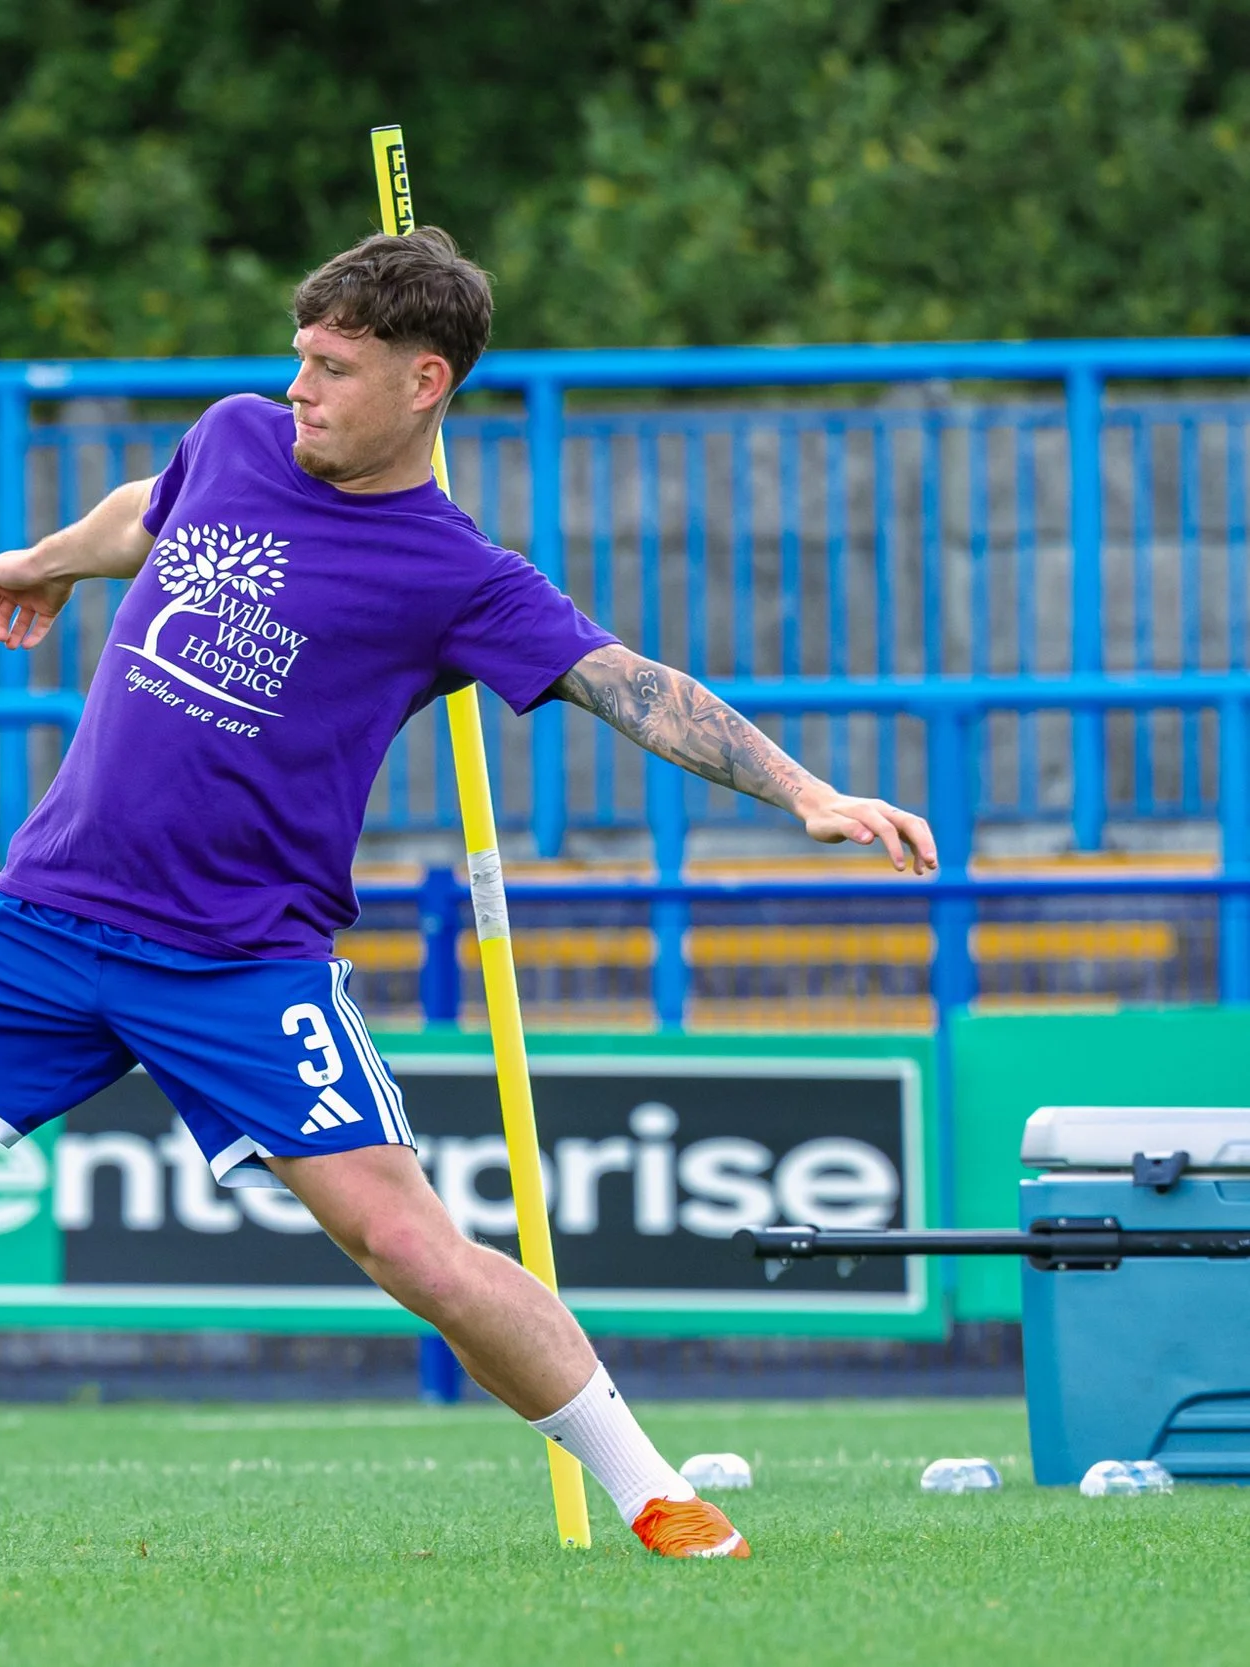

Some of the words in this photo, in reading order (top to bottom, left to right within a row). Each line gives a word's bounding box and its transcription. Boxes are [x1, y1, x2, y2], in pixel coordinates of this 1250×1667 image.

[215, 621, 299, 677] Wood
[218, 593, 309, 651] Willow
[178, 635, 282, 698] Hospice
[125, 665, 185, 708] Together
[185, 703, 214, 722] we
[216, 716, 260, 738] care
[281, 1003, 344, 1088] 3
